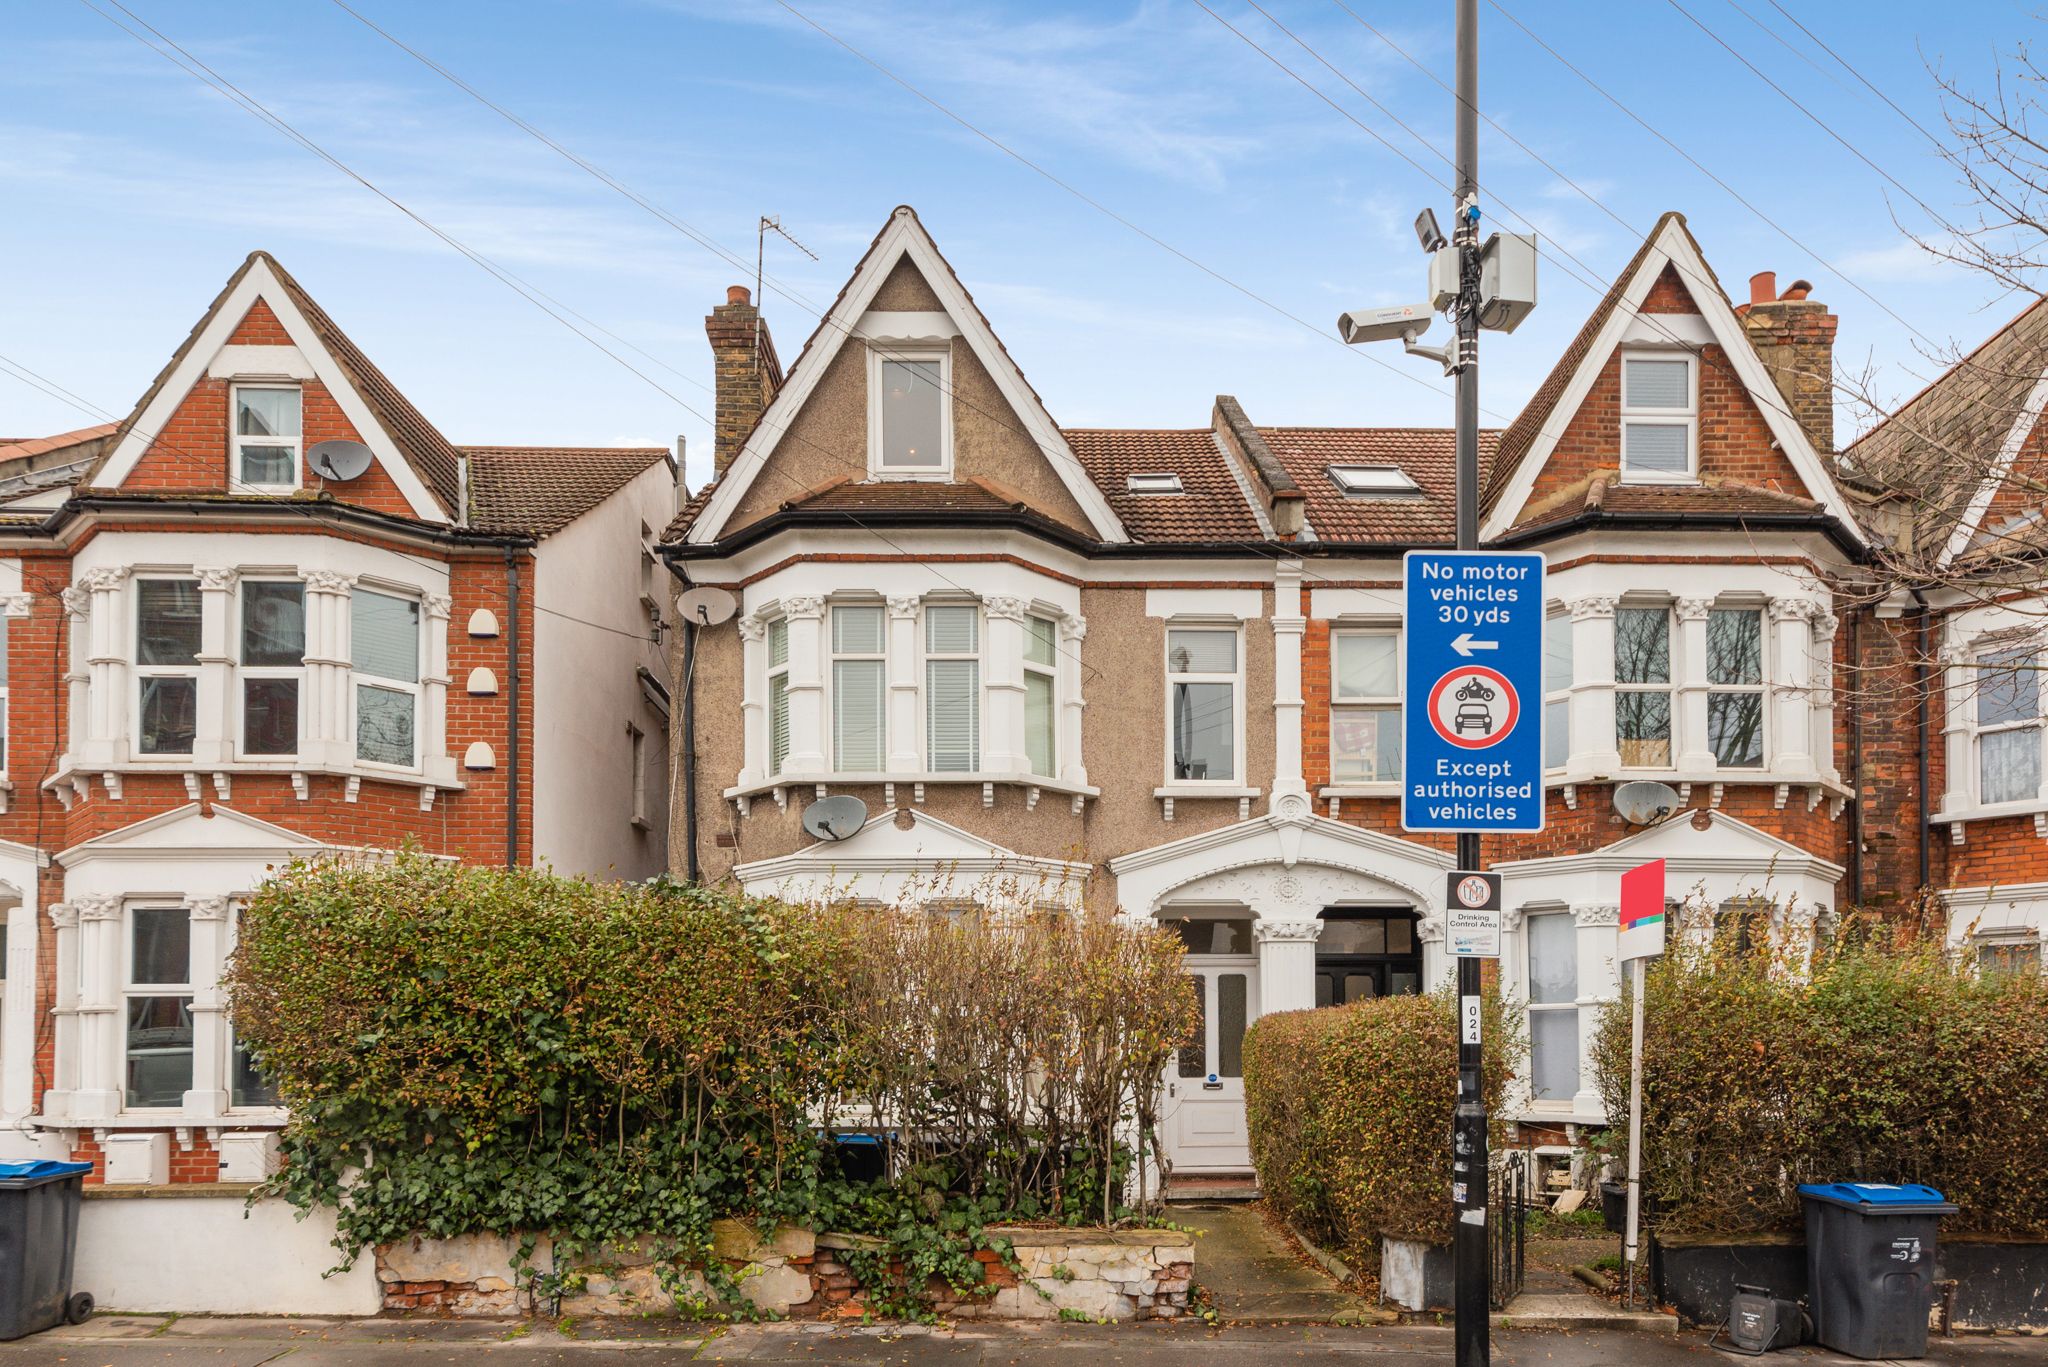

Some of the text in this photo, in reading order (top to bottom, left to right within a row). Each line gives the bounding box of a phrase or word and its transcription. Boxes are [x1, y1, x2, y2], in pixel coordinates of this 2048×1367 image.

[1422, 562, 1529, 580] No motor
[1430, 584, 1518, 602] vehicles
[1438, 605, 1510, 627] 30 yds
[1437, 759, 1512, 779] Except
[1413, 781, 1532, 799] authorised
[1428, 803, 1517, 821] vehicles
[1449, 920, 1498, 929] Control Area
[1457, 913, 1490, 922] Drinking
